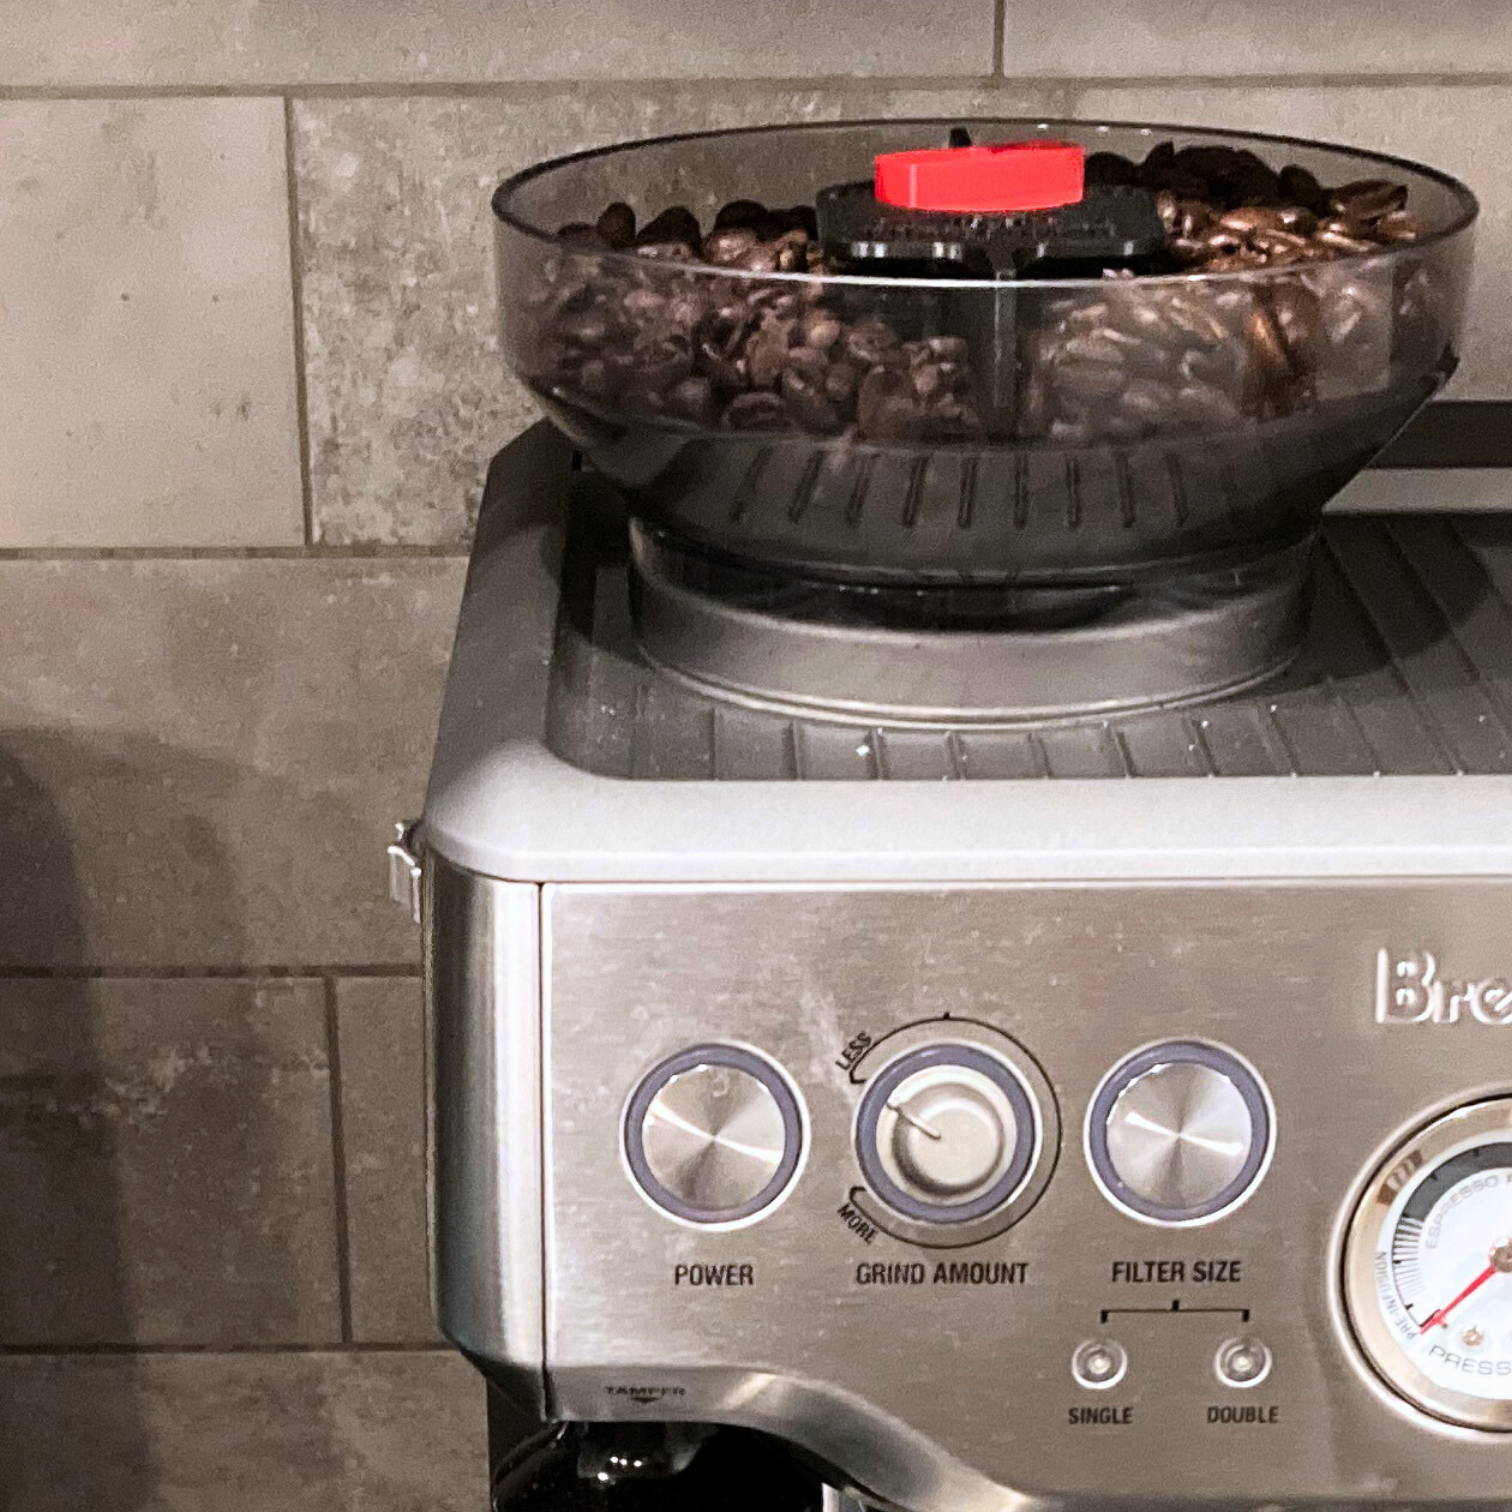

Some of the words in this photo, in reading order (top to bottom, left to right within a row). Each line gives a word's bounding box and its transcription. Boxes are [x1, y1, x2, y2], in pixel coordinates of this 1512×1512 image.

[834, 1030, 872, 1071] LESS
[836, 1202, 878, 1247] MORE
[1425, 1176, 1500, 1250] ESPRESSO
[673, 1263, 755, 1286] POWER
[855, 1261, 926, 1285] GRIND
[932, 1261, 1030, 1285] AMOUNT
[1111, 1260, 1186, 1284] FILTER
[1192, 1260, 1242, 1283] SIZE
[1067, 1406, 1135, 1426] SINGLE
[1206, 1405, 1279, 1424] DOUBLE
